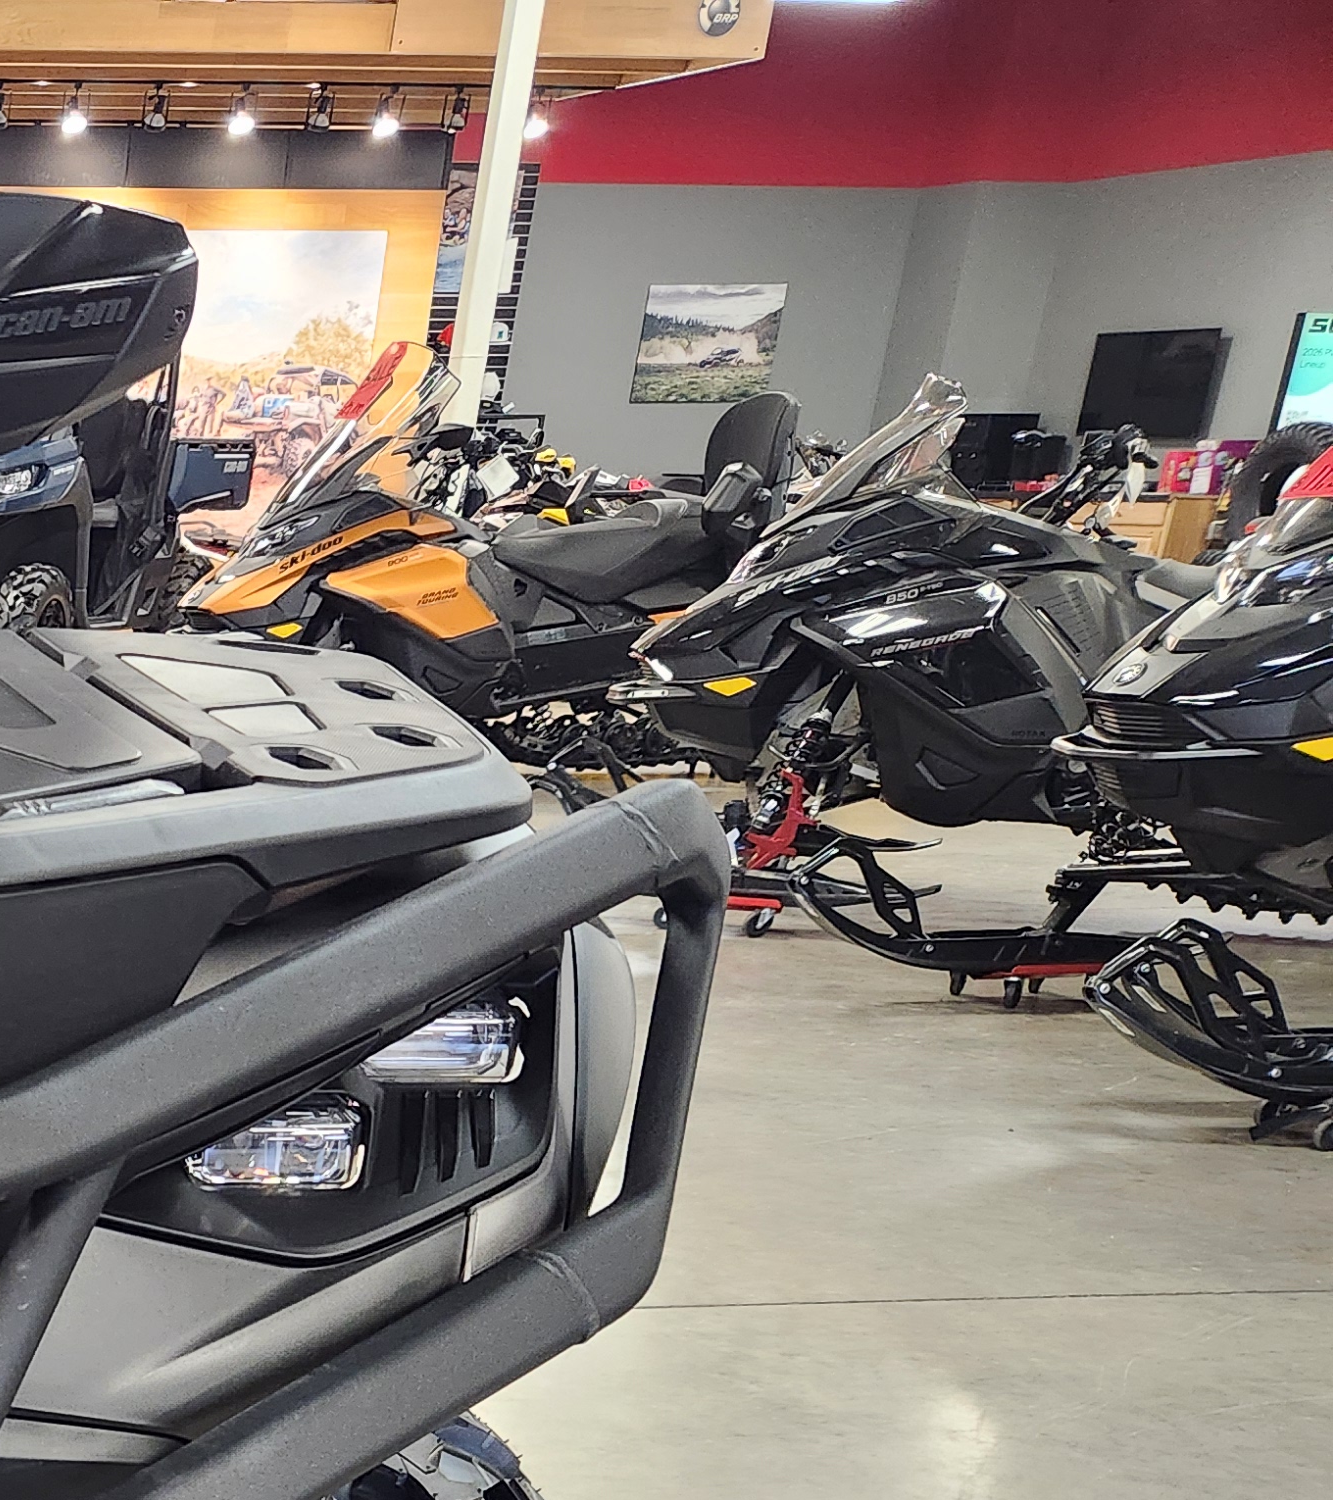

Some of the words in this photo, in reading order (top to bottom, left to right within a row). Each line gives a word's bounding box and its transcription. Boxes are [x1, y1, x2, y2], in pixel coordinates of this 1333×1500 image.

[279, 535, 343, 574] ski-doo
[388, 555, 409, 567] 900
[885, 588, 919, 605] 850
[870, 629, 975, 658] RENEGADE
